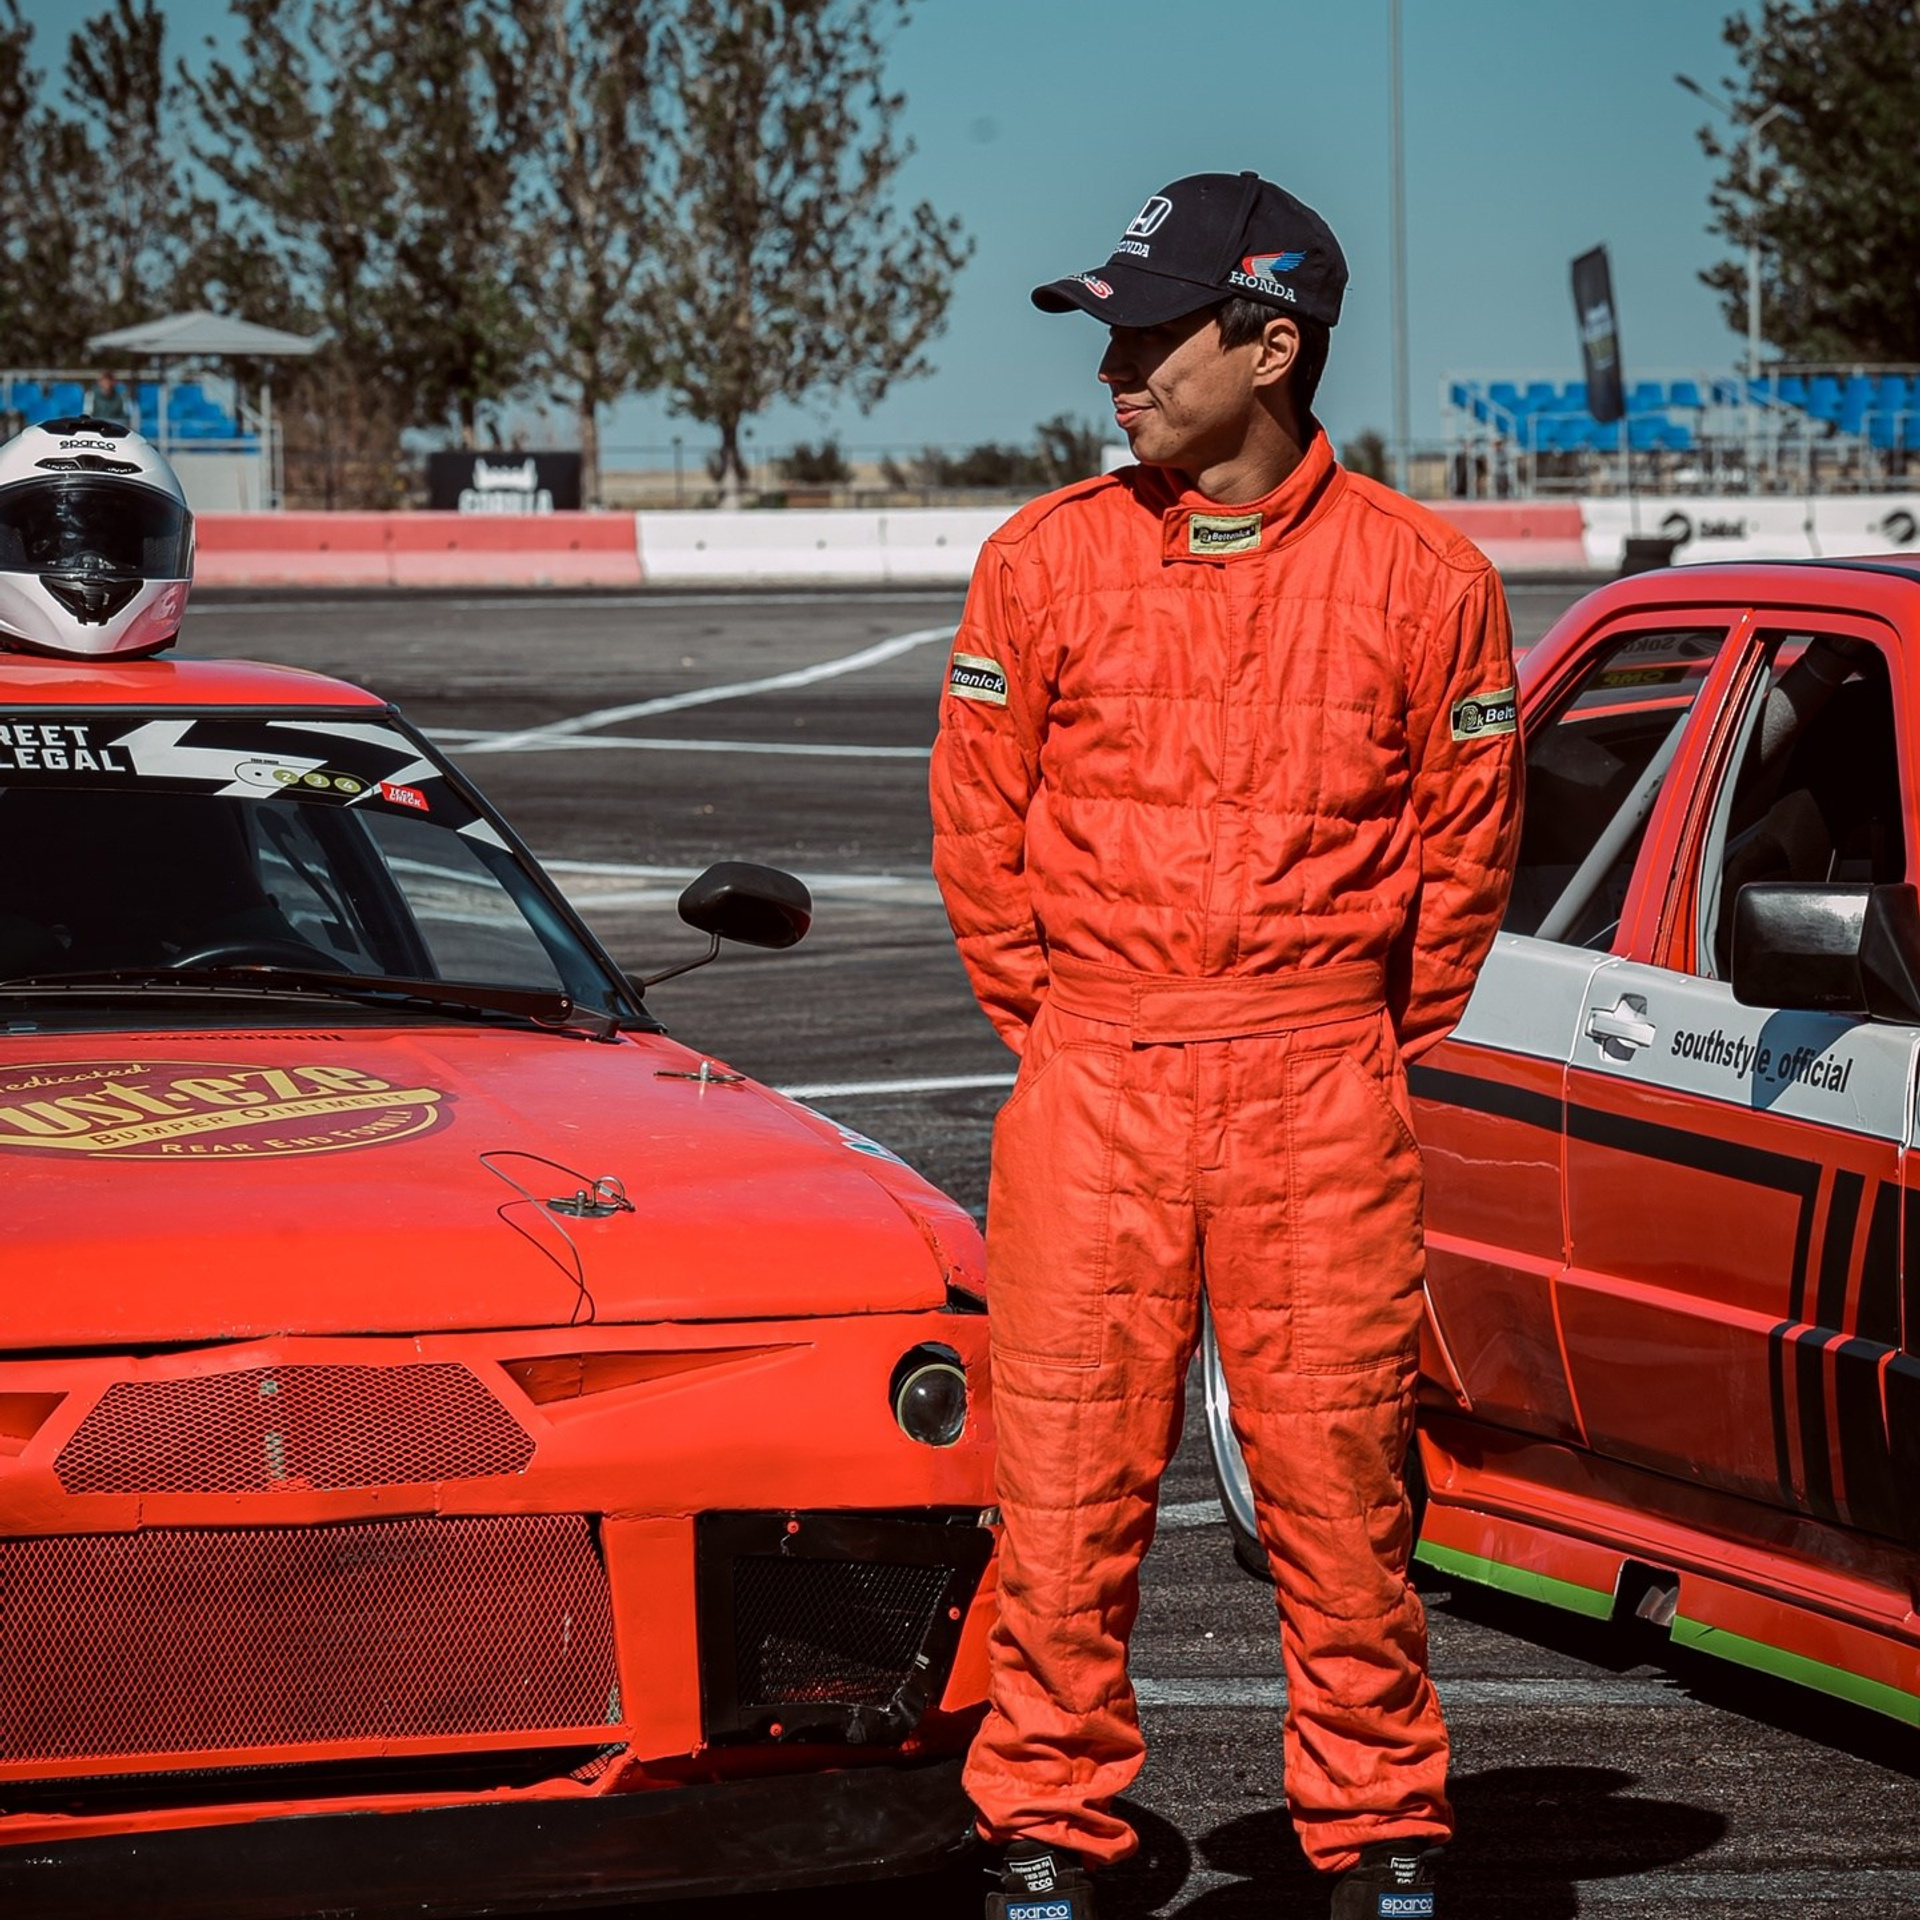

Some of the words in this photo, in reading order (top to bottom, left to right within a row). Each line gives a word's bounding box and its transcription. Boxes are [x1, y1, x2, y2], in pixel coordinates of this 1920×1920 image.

[1115, 240, 1150, 258] ONDA
[1228, 271, 1297, 303] HONDA
[59, 439, 116, 452] sparco
[282, 772, 292, 782] 2
[390, 787, 414, 798] TECH
[390, 793, 421, 806] CHECK
[1671, 1029, 1853, 1093] southstyle_official
[0, 1064, 150, 1093] edicated
[89, 1115, 230, 1145] BUMPER
[240, 1093, 406, 1119] OINTMENT
[161, 1142, 254, 1153] REAR
[263, 1136, 333, 1149] END
[1009, 1904, 1068, 1920] sparco
